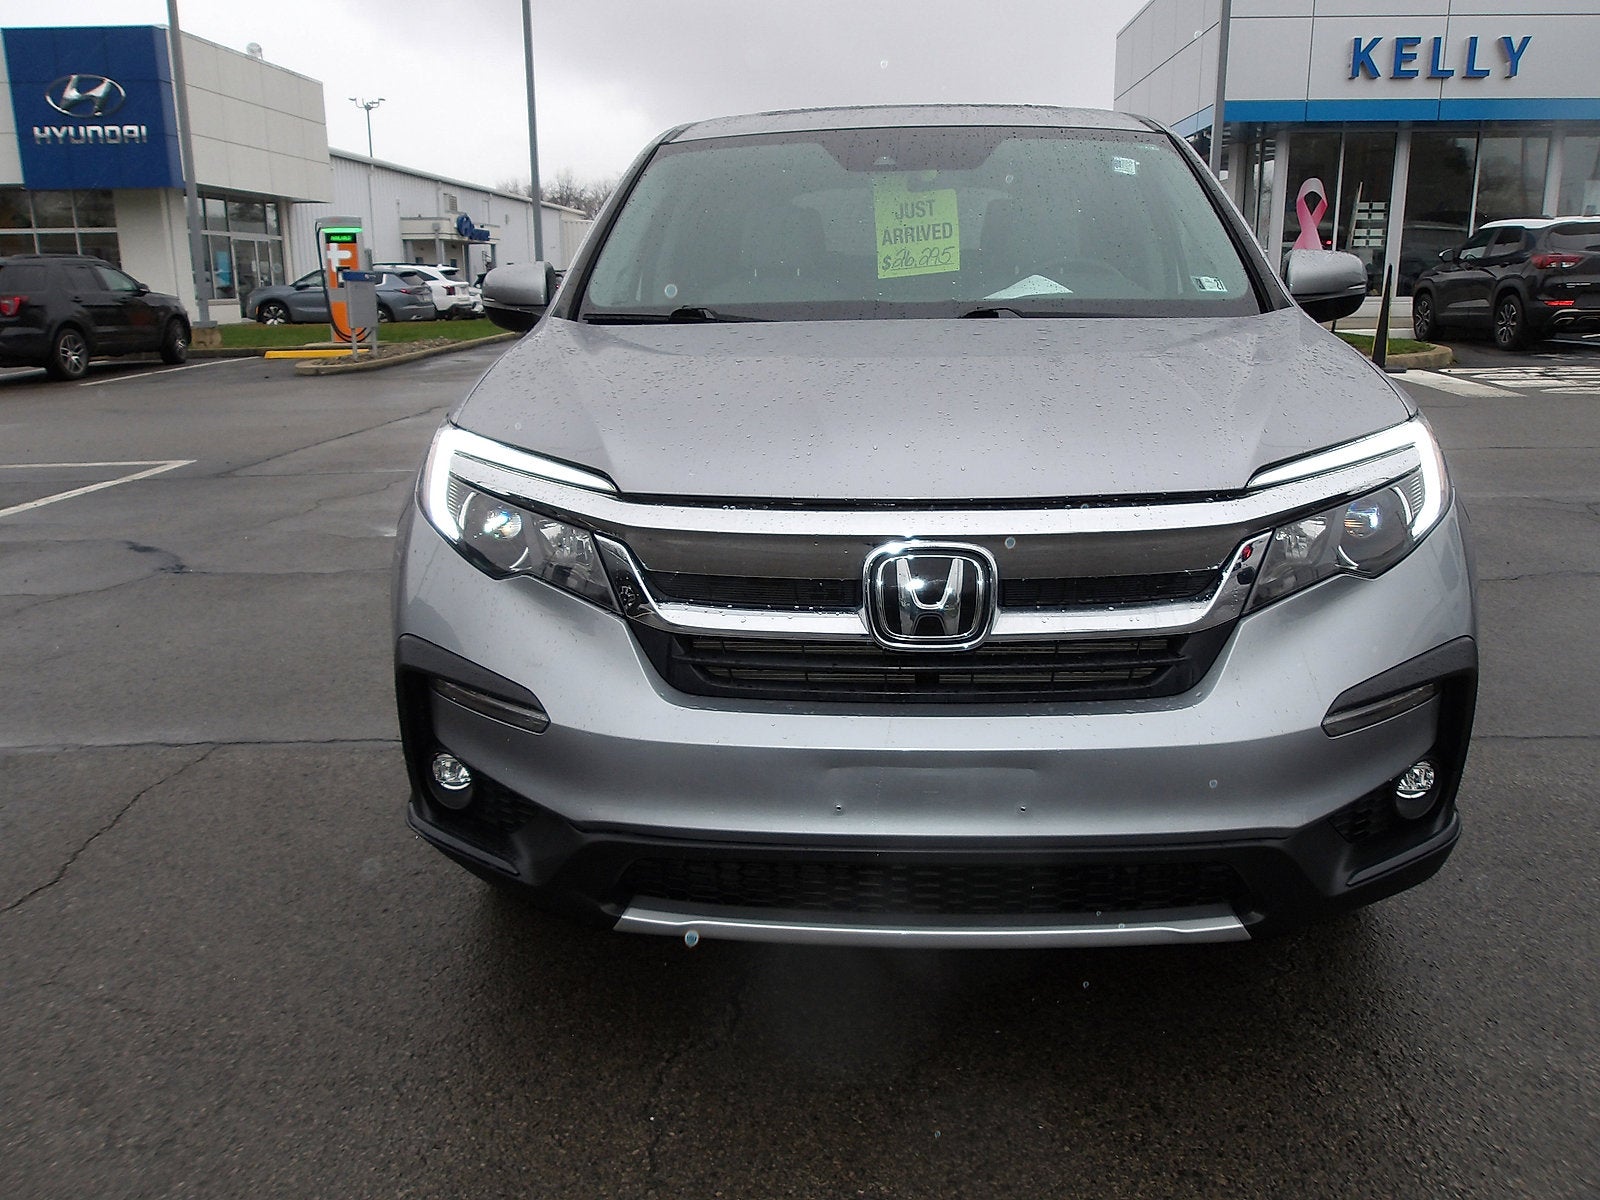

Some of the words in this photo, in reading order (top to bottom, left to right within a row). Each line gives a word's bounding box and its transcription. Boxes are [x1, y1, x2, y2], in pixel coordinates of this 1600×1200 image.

[1348, 35, 1533, 79] KELLY
[32, 124, 147, 144] HYUNDAI
[895, 199, 934, 219] JUST
[882, 222, 953, 246] ARRIVED
